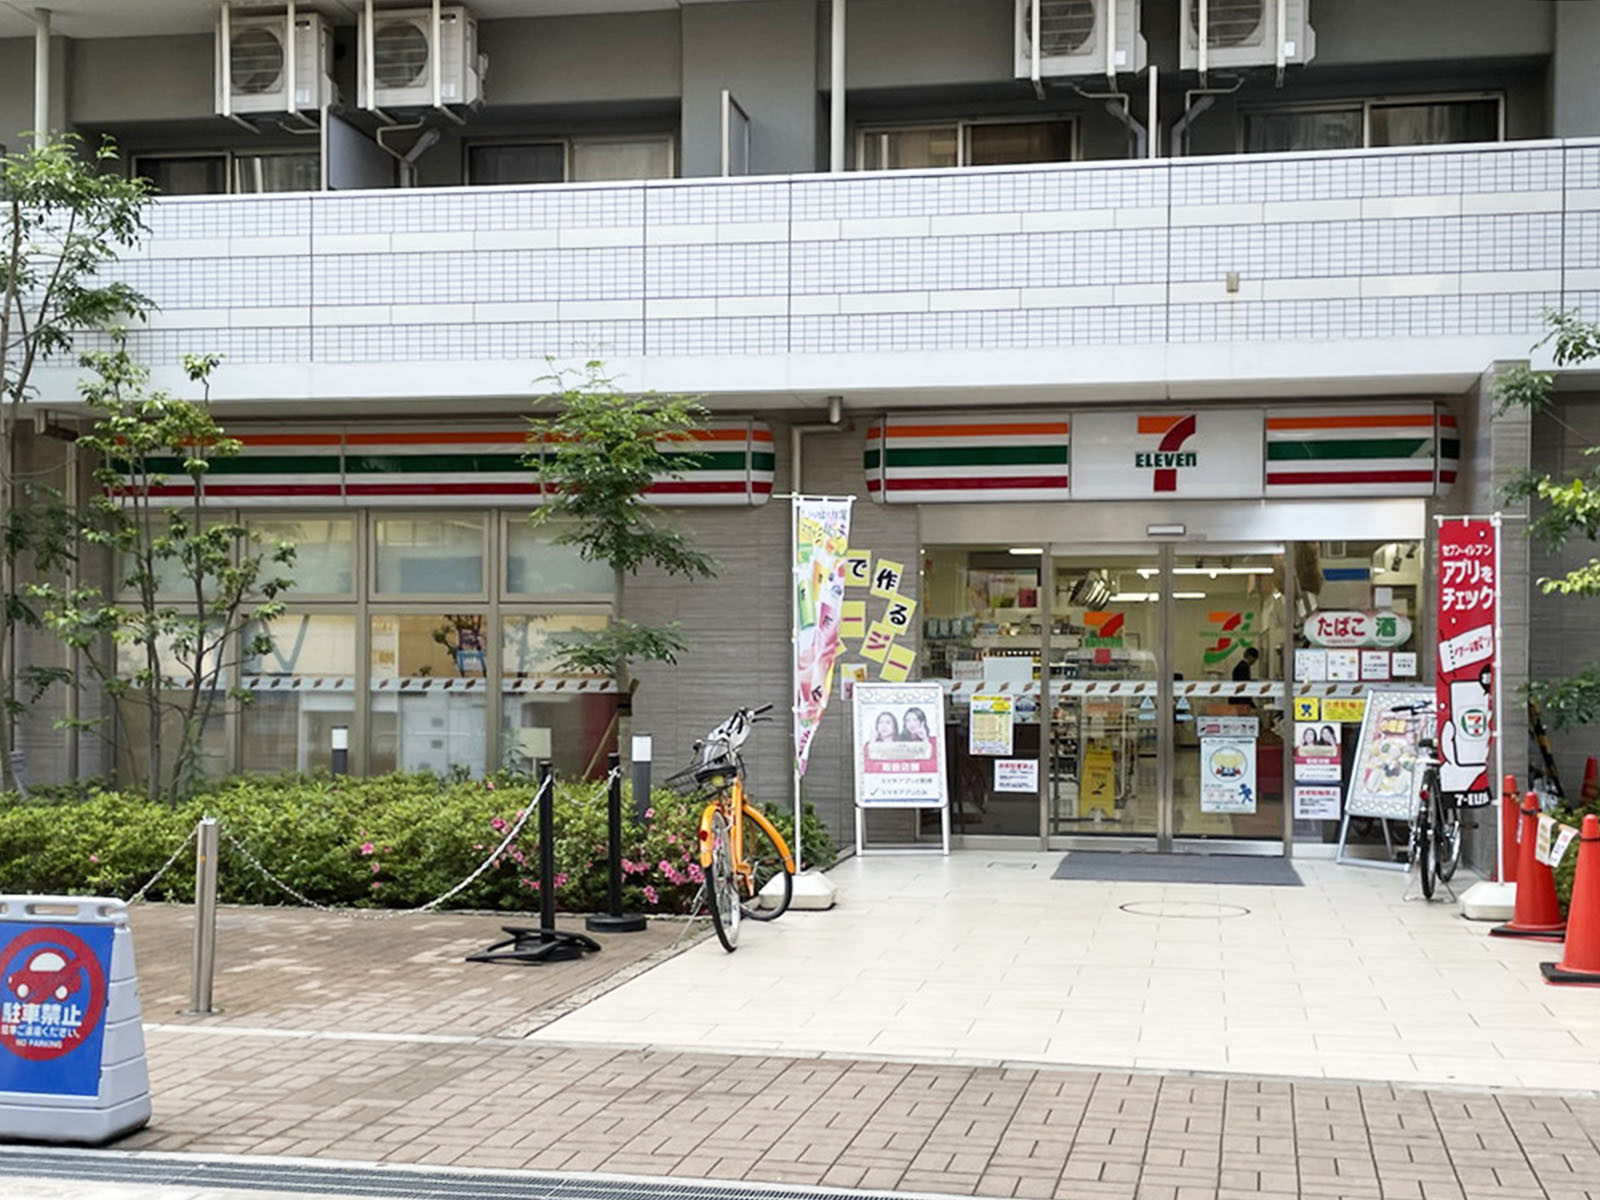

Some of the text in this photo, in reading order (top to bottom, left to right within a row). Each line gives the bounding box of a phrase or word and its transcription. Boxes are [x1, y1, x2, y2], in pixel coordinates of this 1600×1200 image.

[1137, 414, 1196, 492] 7
[1442, 560, 1493, 585] アプリを
[1442, 586, 1494, 611] チェック
[1317, 617, 1396, 637] たばこ 酒
[2, 1002, 82, 1026] 駐車禁止
[16, 1039, 62, 1048] NO PARKING
